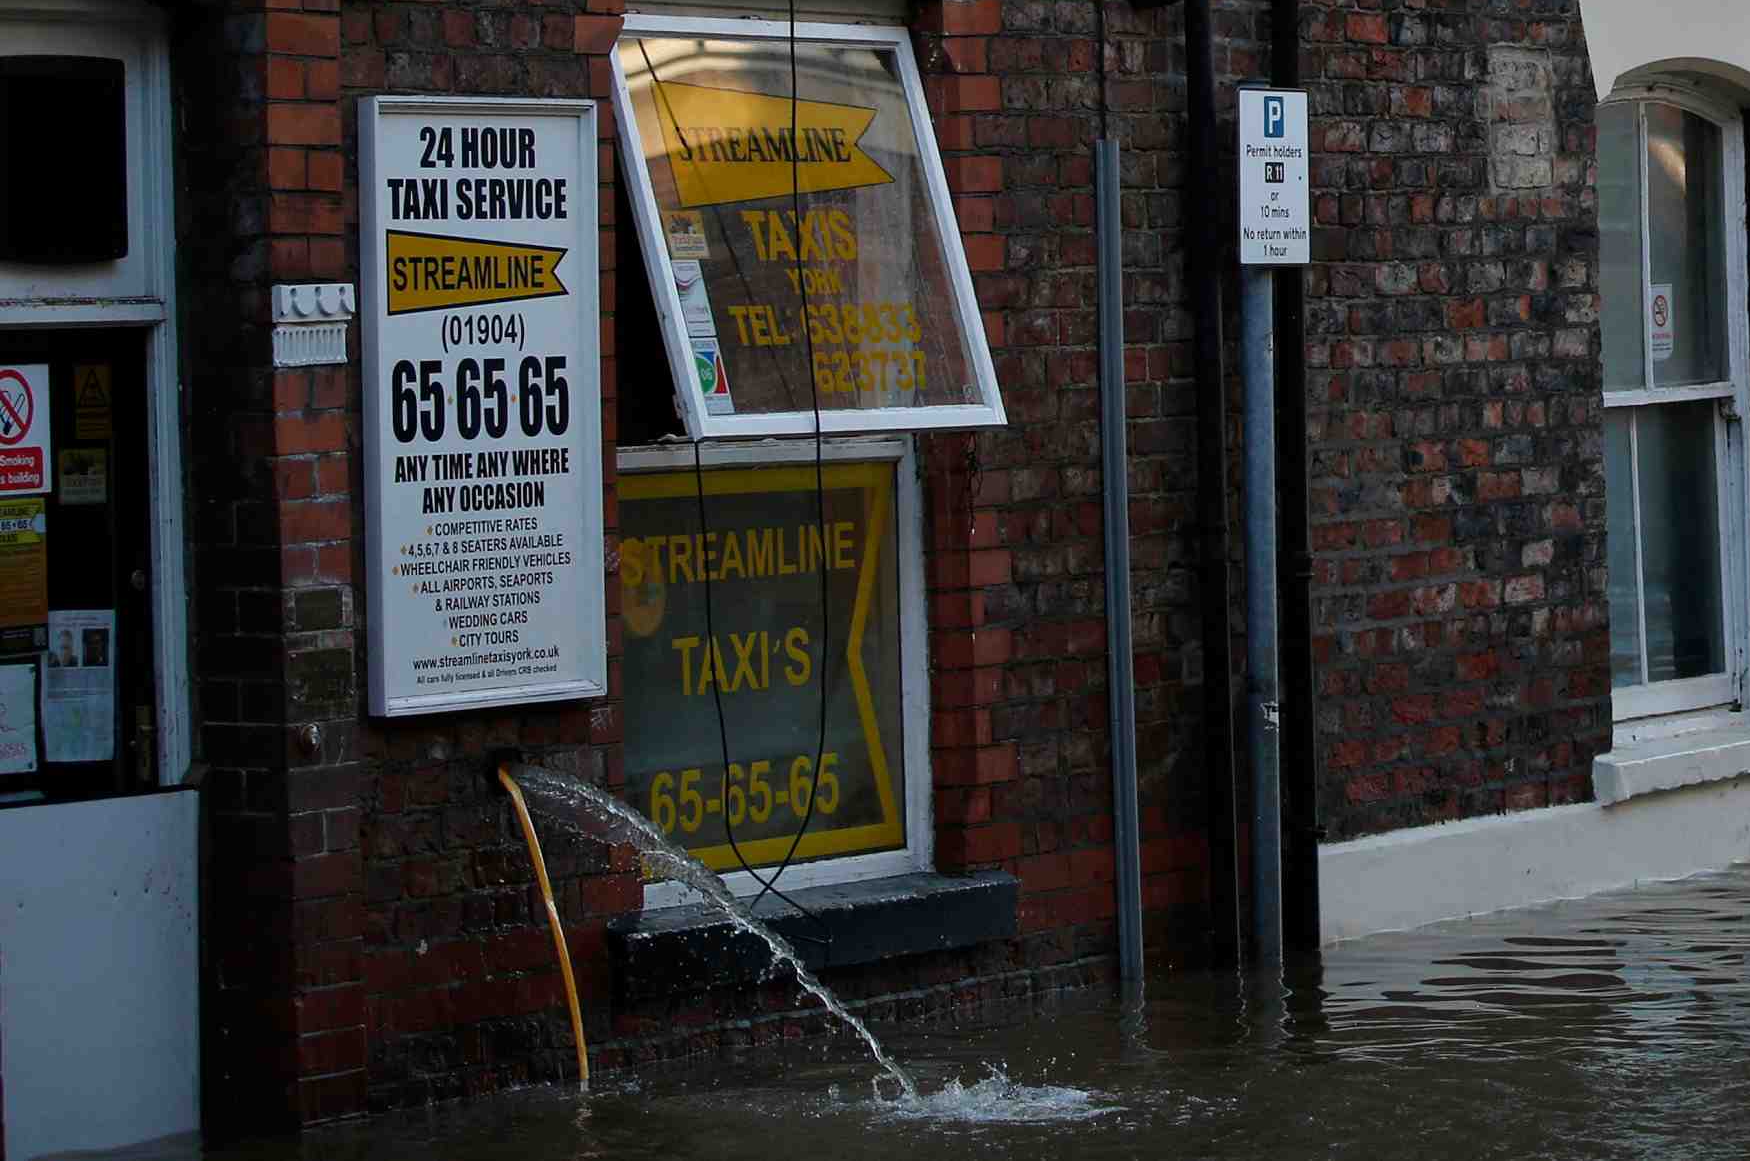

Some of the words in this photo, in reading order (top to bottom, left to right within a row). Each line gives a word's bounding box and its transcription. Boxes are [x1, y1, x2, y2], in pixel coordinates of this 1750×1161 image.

[1267, 100, 1282, 134] P
[420, 126, 455, 168] 24
[461, 127, 536, 169] HOUR
[677, 126, 852, 164] STREAMLINE
[1246, 144, 1272, 159] Permit
[1273, 145, 1302, 159] holders
[387, 178, 448, 220] TAXI
[456, 178, 567, 220] SERVICE
[1270, 192, 1279, 202] or
[1260, 206, 1270, 218] 10
[1271, 207, 1290, 218] mins
[741, 209, 857, 262] TAXIS
[1243, 227, 1254, 240] No
[1256, 228, 1281, 240] return
[1283, 227, 1307, 240] within
[1263, 245, 1268, 256] 1
[1269, 245, 1288, 257] hour
[393, 255, 545, 292] STREAMLINE
[785, 268, 843, 296] YORK
[441, 313, 525, 353] (01904)
[394, 455, 428, 483] ANY
[431, 453, 473, 480] TIME
[476, 451, 508, 478] ANY
[512, 448, 569, 476] WHERE
[422, 486, 456, 514] ANY
[459, 481, 545, 512] OCCASION
[435, 519, 503, 536] COMPETITIVE
[505, 517, 538, 532] RATES
[408, 542, 439, 558] 4,5,6,7
[443, 541, 450, 555] &
[452, 541, 458, 554] 8
[461, 537, 507, 553] SEATERS
[509, 534, 563, 550] AVAILABLE
[619, 521, 857, 585] STREAMLINE
[400, 559, 470, 576] WHEELCHAIR
[472, 556, 521, 572] FRIENDLY
[523, 552, 571, 567] VEHICLES
[420, 580, 440, 593] ALL
[500, 572, 553, 588] SEAPORTS
[435, 599, 442, 611] &
[445, 595, 490, 611] RAILWAY
[492, 591, 540, 607] STATIONS
[449, 613, 497, 629] WEDDING
[500, 611, 528, 625] CARS
[459, 633, 482, 647] CITY
[485, 630, 519, 644] TOURS
[412, 645, 560, 670] www.streamlinetaxisyork.co.uk
[672, 626, 813, 697] TAXI'S
[427, 675, 440, 684] cars
[441, 671, 454, 684] fully
[533, 663, 557, 673] checked
[650, 751, 840, 835] 65-65-65
